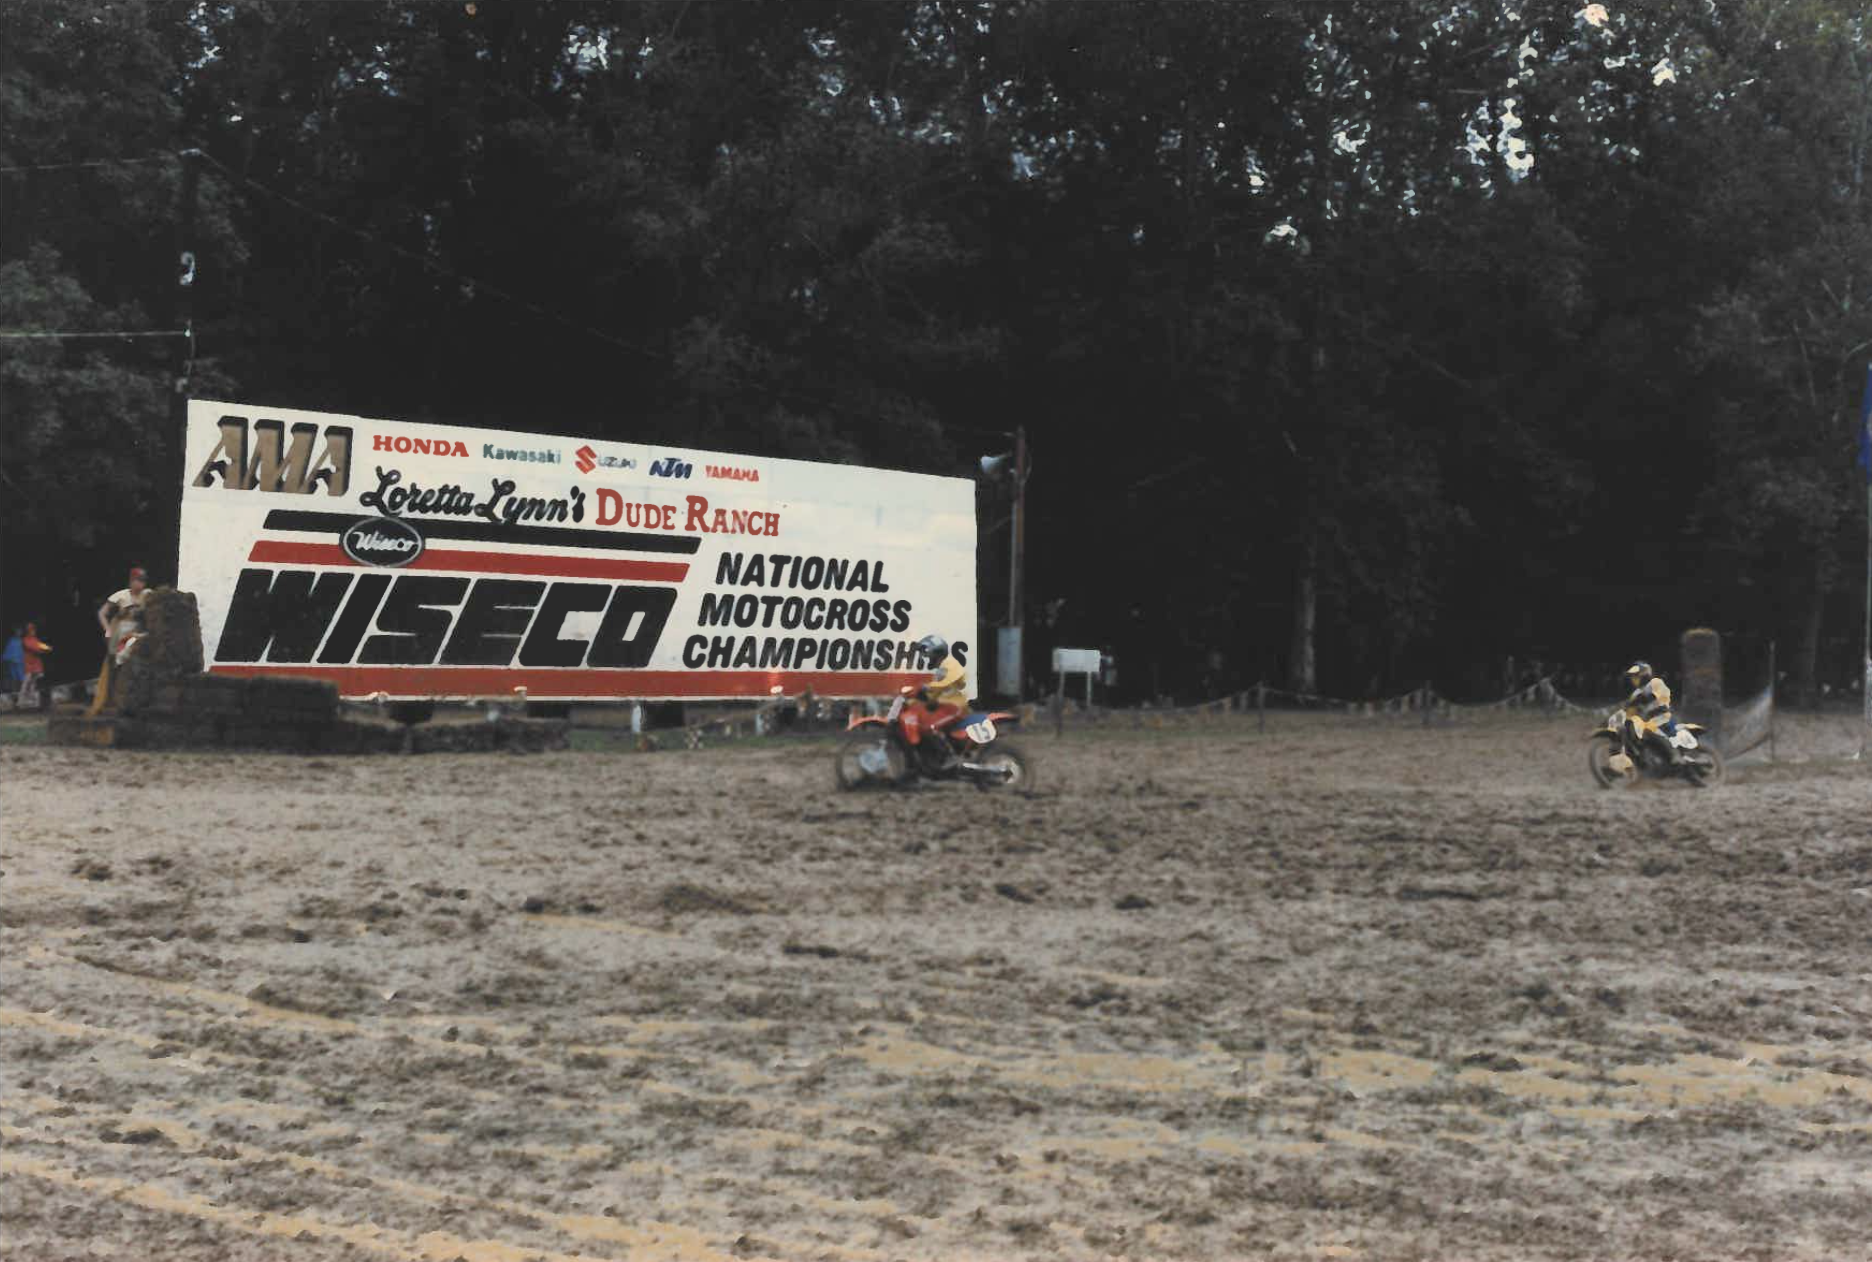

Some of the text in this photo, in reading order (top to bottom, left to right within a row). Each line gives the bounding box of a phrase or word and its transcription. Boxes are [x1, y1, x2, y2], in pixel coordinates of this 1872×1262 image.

[192, 415, 354, 497] AMA
[373, 434, 470, 458] HONDA
[483, 443, 562, 464] Kawasaki
[649, 457, 693, 479] KTM
[706, 464, 760, 482] YAMAHA
[359, 466, 475, 518] Loretta
[474, 478, 586, 526] Lynn's
[715, 552, 890, 594] NATIONAL
[213, 568, 678, 668] WISECO
[697, 593, 912, 633] MOTOCROSS
